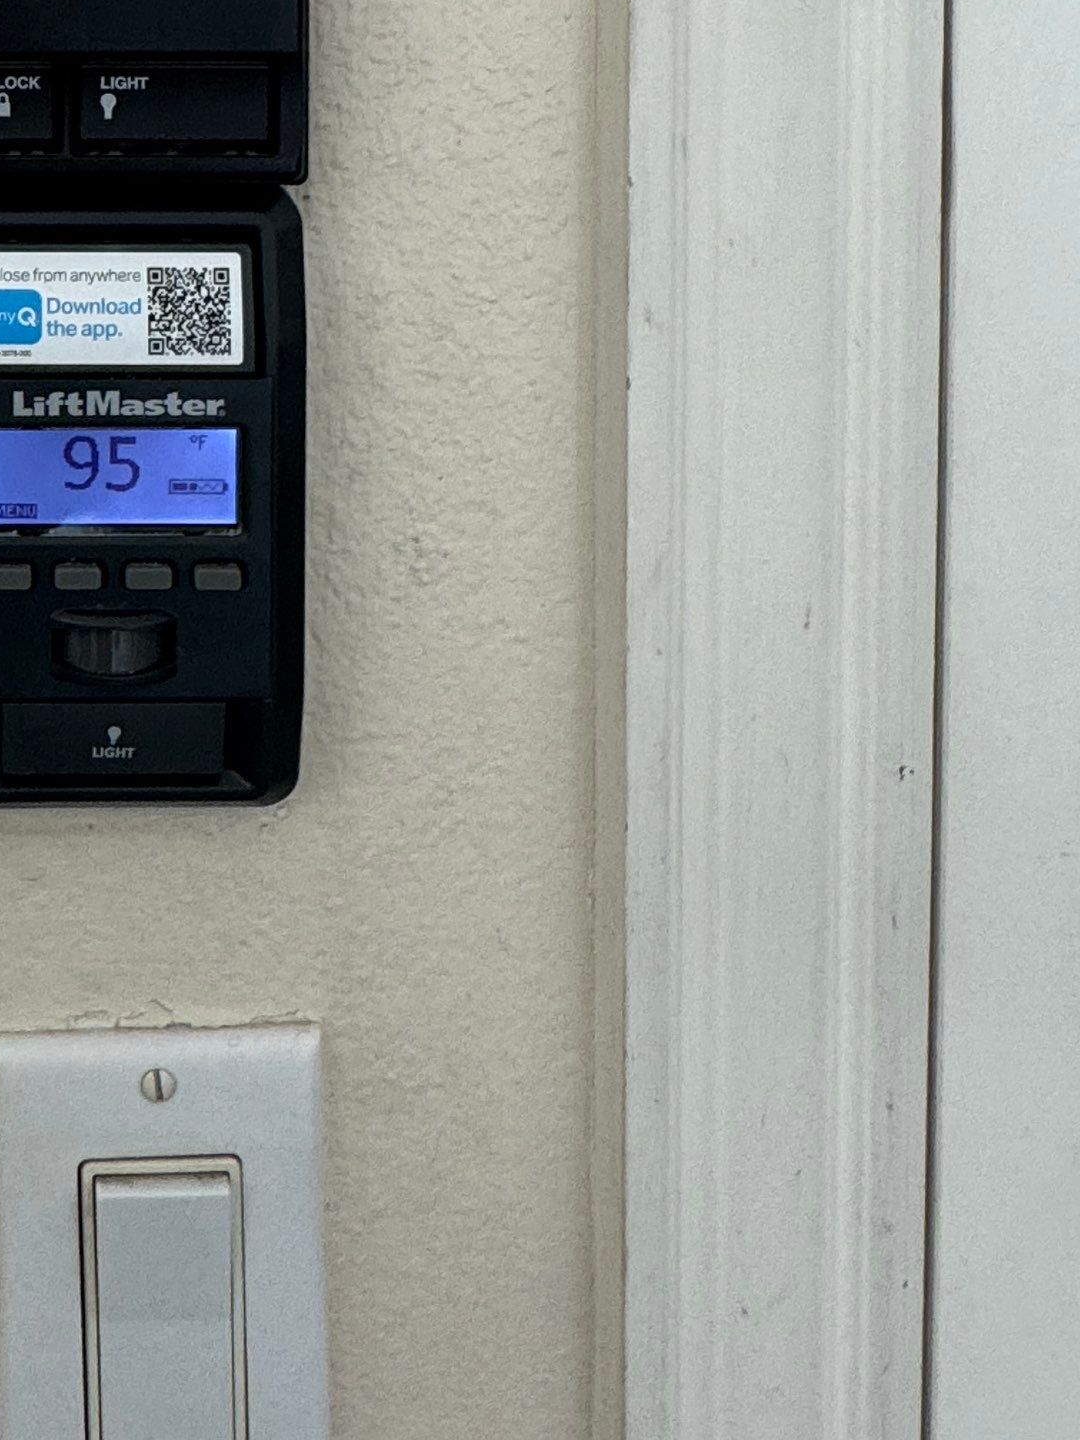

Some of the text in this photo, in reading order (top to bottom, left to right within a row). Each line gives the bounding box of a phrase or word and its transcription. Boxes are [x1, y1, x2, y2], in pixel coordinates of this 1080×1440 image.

[100, 75, 150, 90] LIGHT
[32, 266, 67, 283] from
[69, 267, 142, 285] anywhere
[46, 297, 142, 315] Download
[46, 319, 124, 341] the app.
[12, 389, 225, 417] LiftMaster
[62, 434, 141, 493] 95
[92, 746, 137, 759] LIGHT
